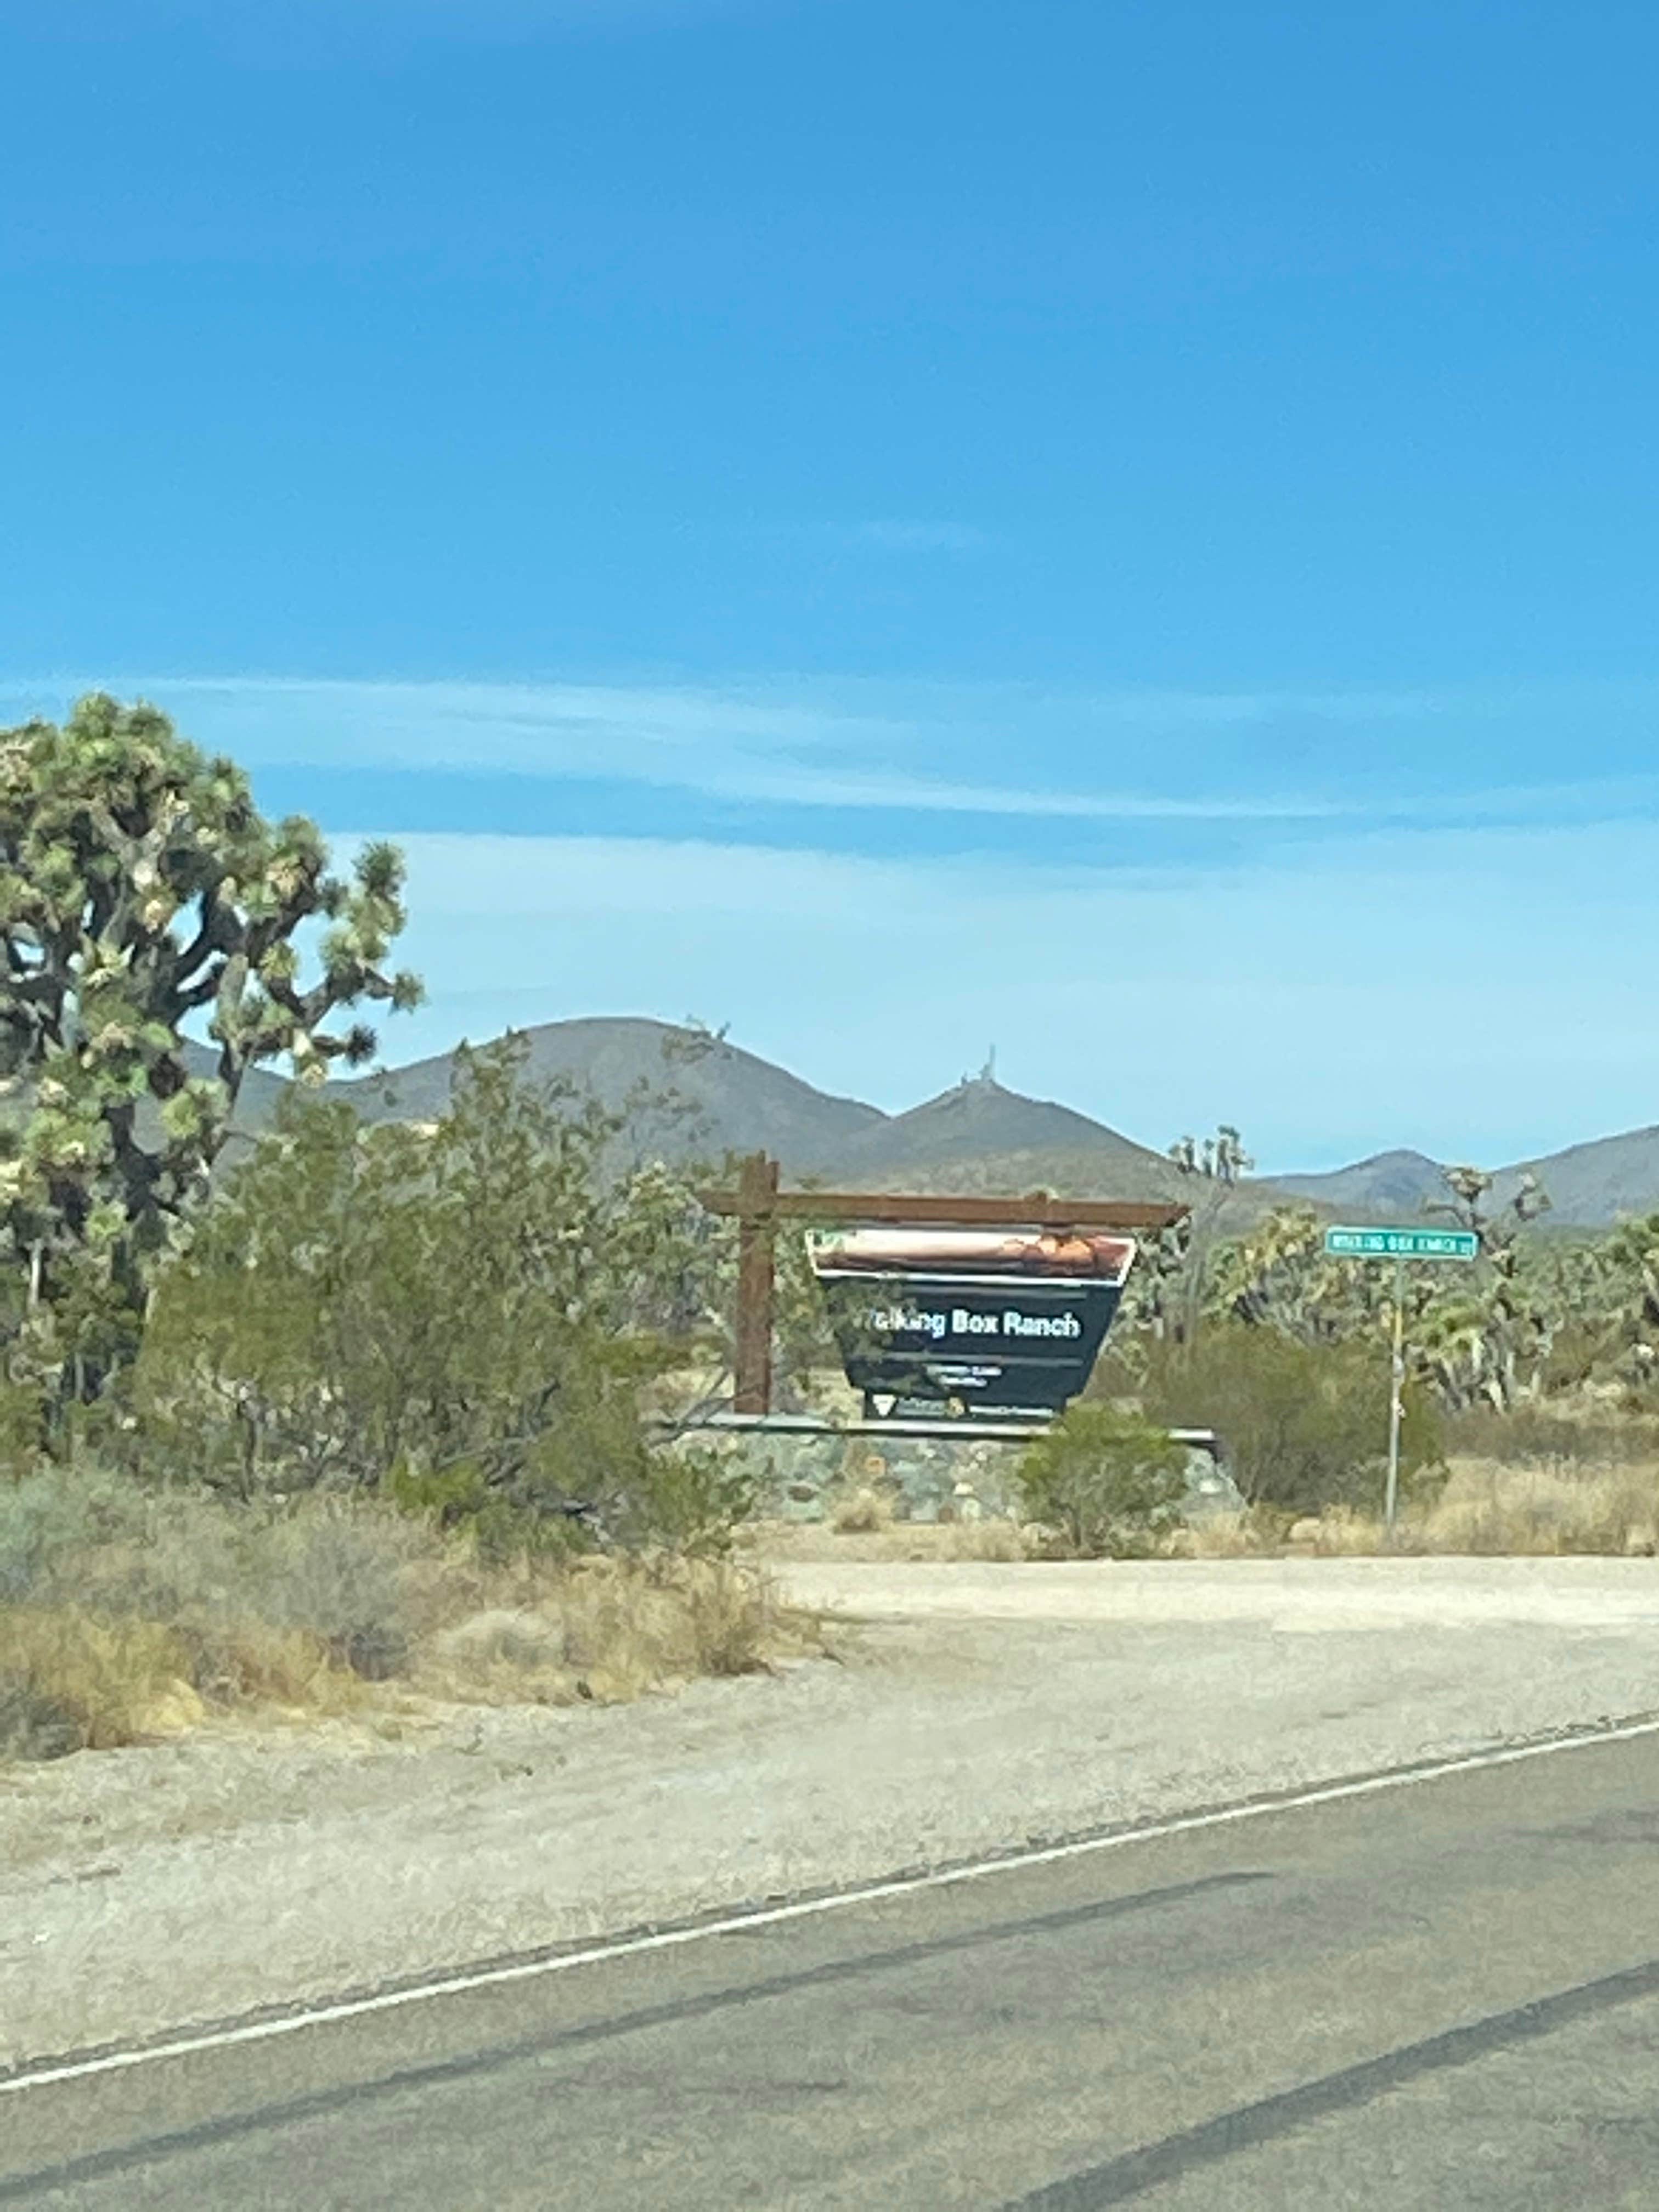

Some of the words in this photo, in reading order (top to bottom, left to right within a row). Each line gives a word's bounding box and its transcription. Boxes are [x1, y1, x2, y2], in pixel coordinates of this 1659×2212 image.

[866, 1307, 945, 1339] alking
[952, 1309, 999, 1333] Box
[1003, 1312, 1081, 1339] Ranch
